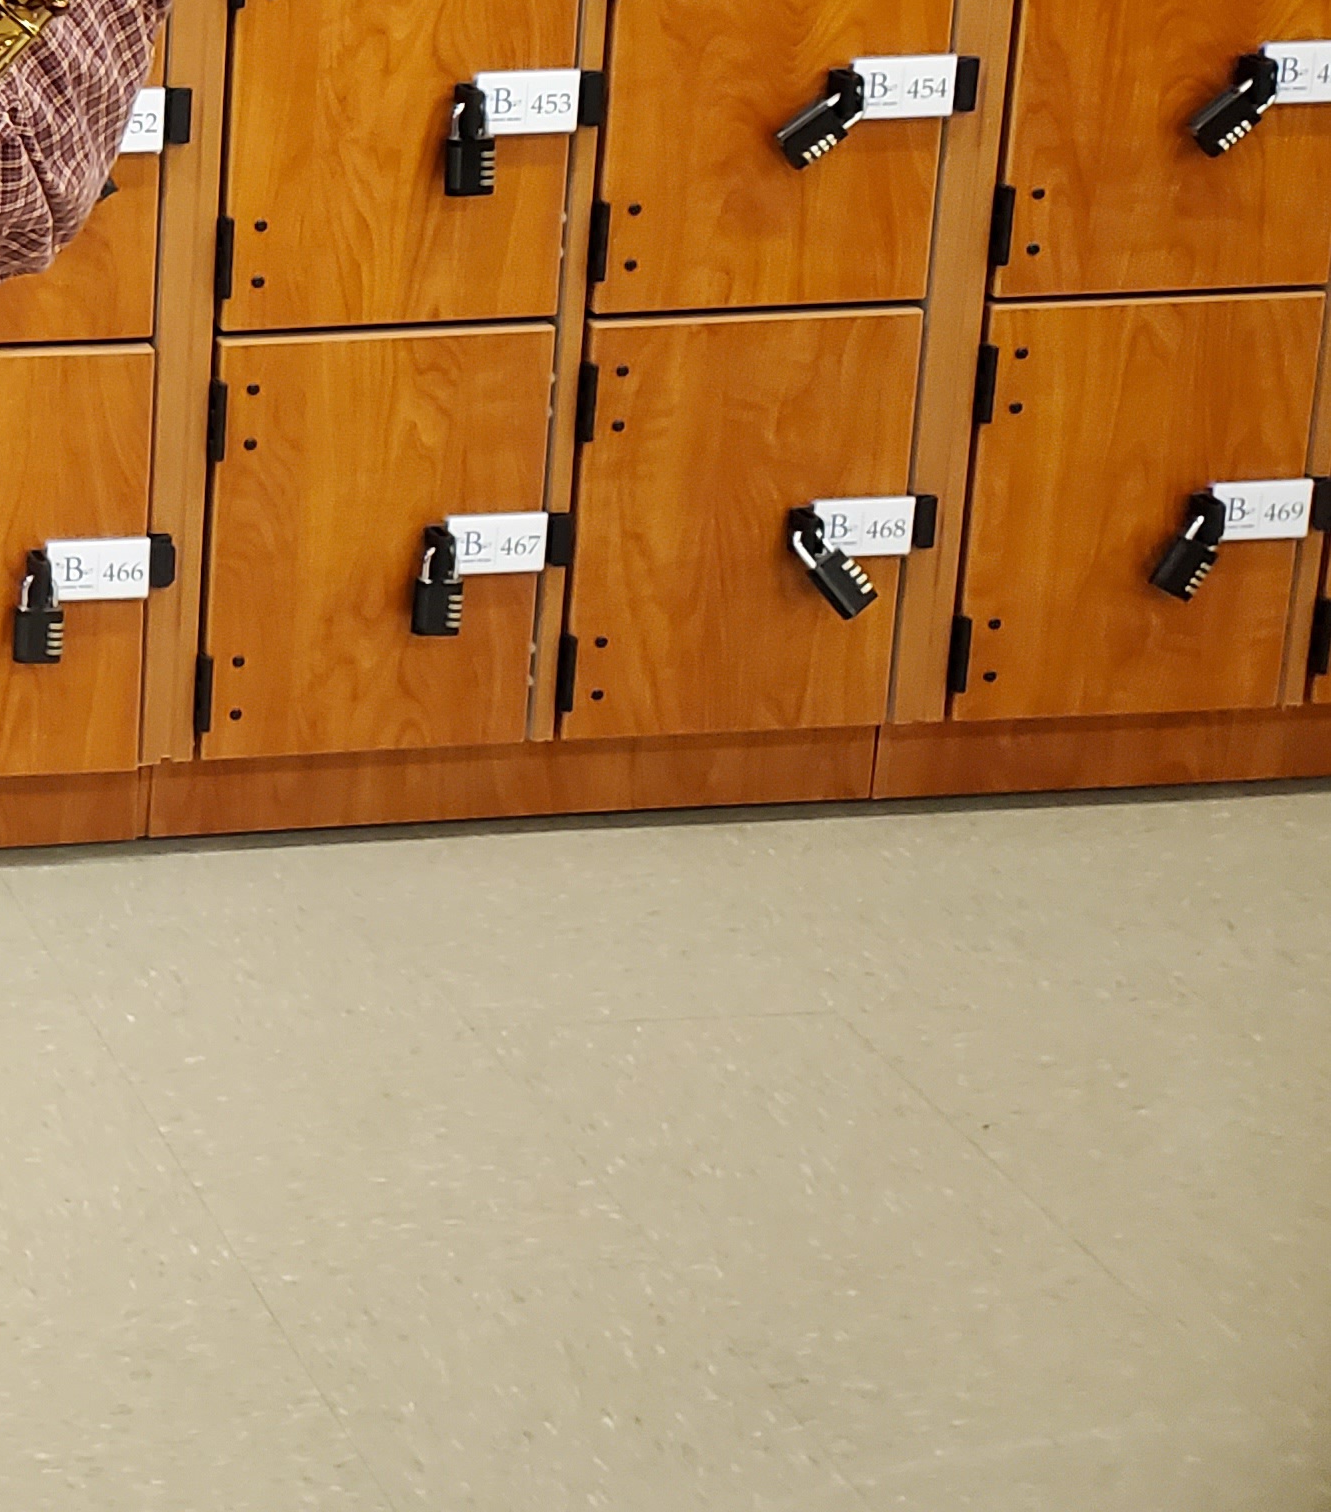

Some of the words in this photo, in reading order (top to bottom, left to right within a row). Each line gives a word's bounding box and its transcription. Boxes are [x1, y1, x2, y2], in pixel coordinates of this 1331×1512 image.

[1280, 57, 1301, 83] B
[869, 72, 891, 99] B
[907, 78, 946, 99] 454
[493, 88, 512, 114] B
[531, 93, 571, 114] 453
[130, 113, 158, 134] 52
[1228, 498, 1249, 521] B
[1264, 502, 1304, 521] 469
[828, 514, 851, 540] B
[866, 519, 905, 539] 468
[464, 531, 484, 556] B
[500, 535, 541, 555] 467
[64, 557, 85, 581] B
[103, 562, 143, 582] 466
